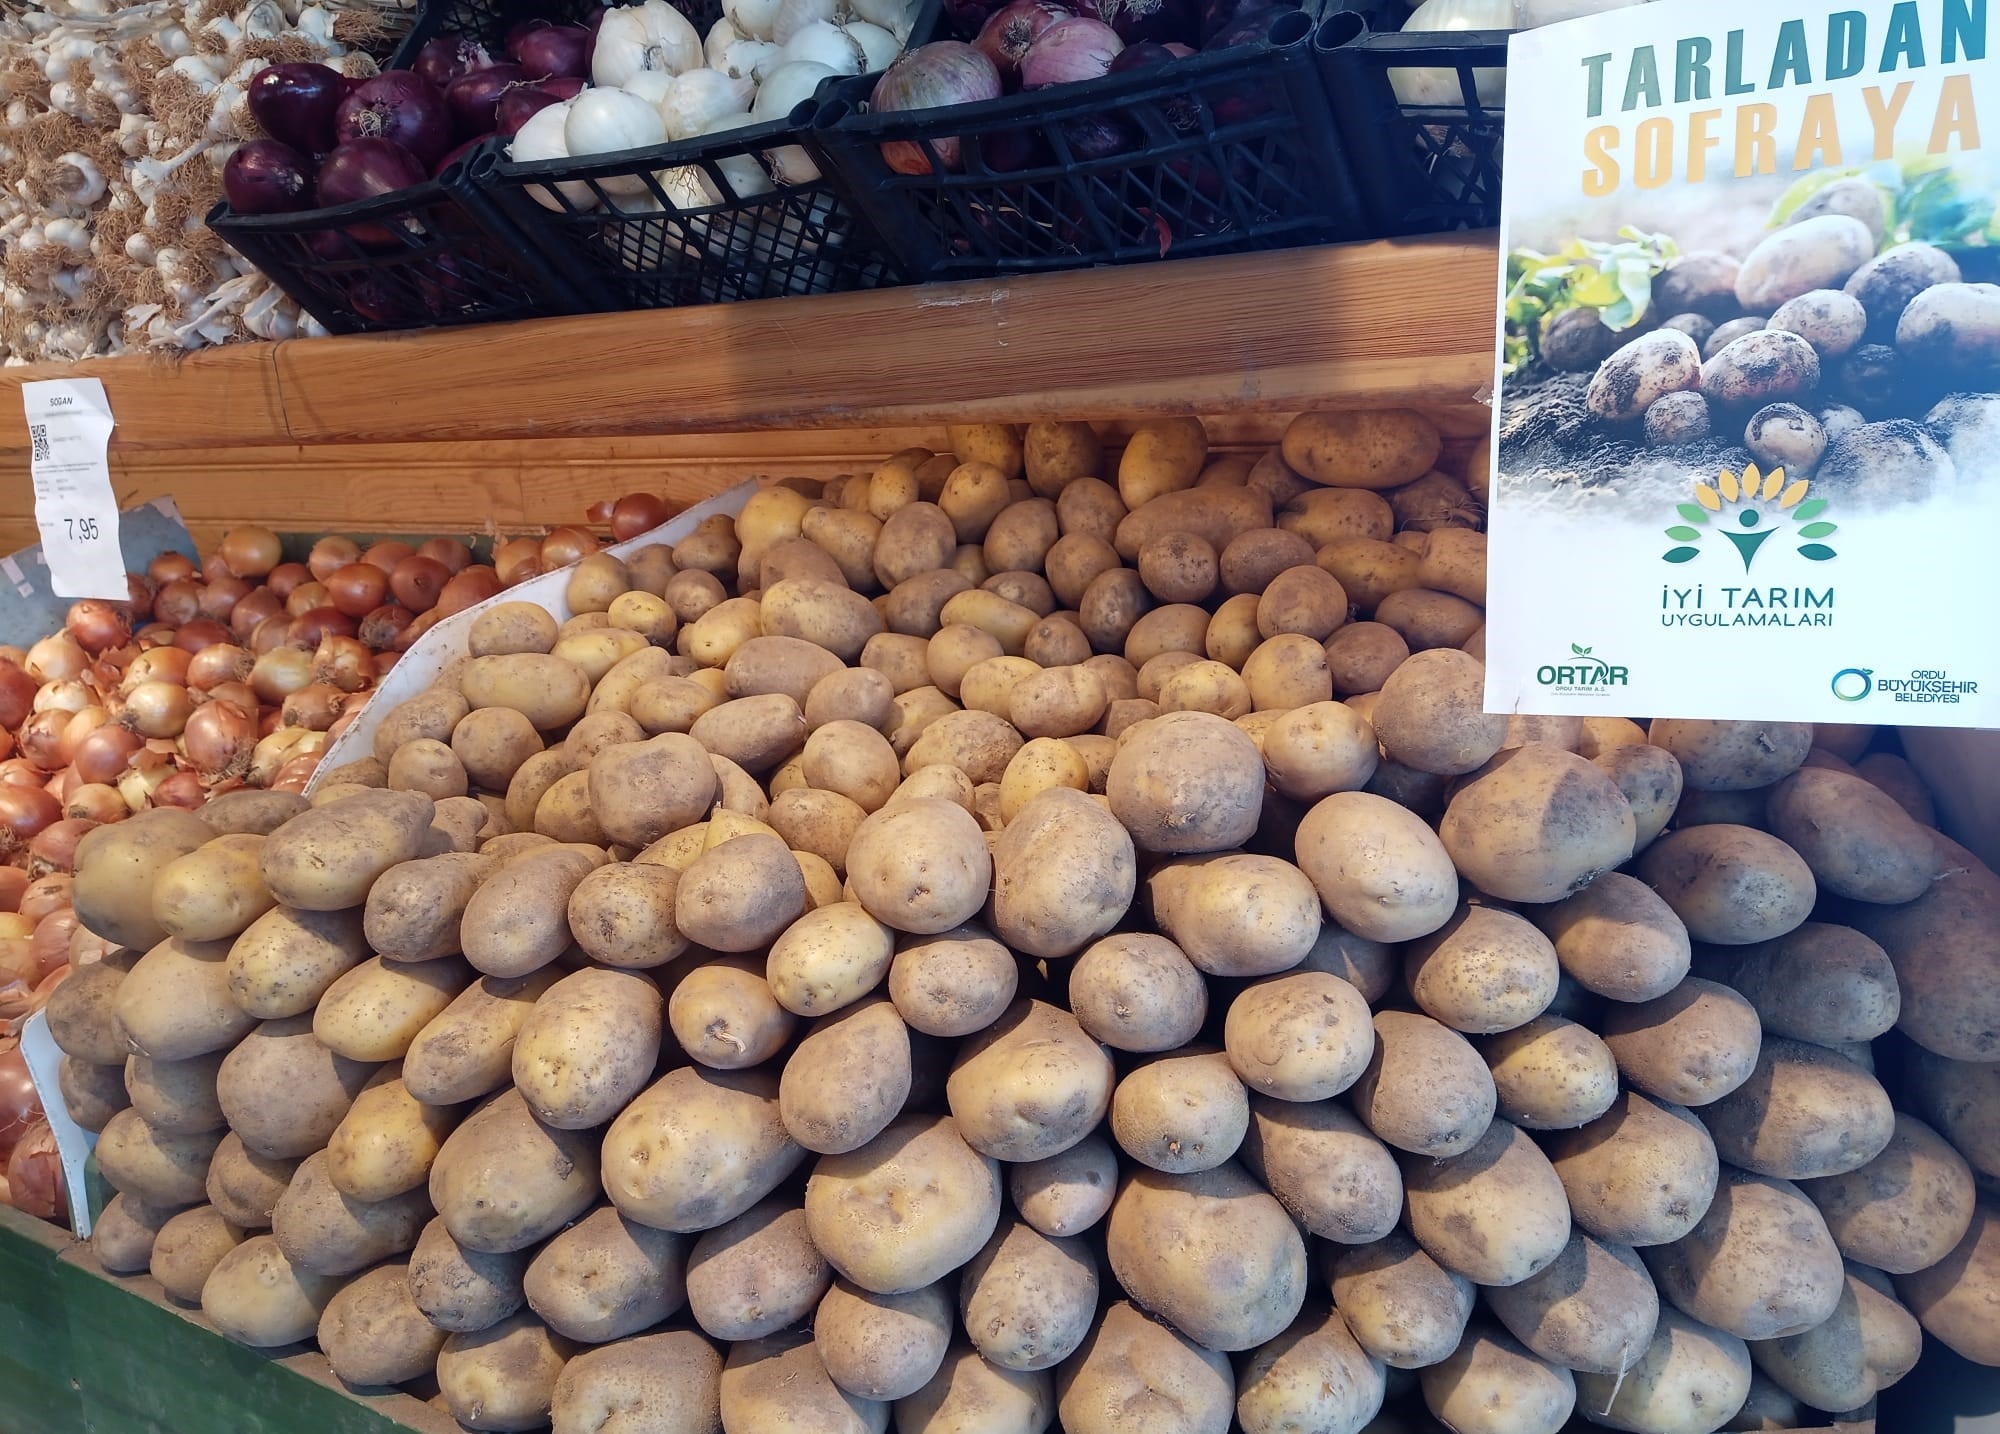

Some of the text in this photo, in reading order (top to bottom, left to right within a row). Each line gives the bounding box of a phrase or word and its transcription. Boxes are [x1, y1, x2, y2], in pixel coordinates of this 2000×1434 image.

[1581, 0, 1987, 118] TARLADAN
[1581, 73, 1982, 199] SOFRAYA
[63, 517, 99, 544] 7,95
[1661, 583, 1834, 609] İYİ TARIM
[1661, 613, 1833, 627] UYGULAMALARI
[1536, 665, 1629, 686] ORTAR
[1911, 669, 1946, 680] ORDU
[1877, 679, 1979, 694] BÜYÜKŞEHİR
[1895, 692, 1960, 704] BELEDİYESİ
